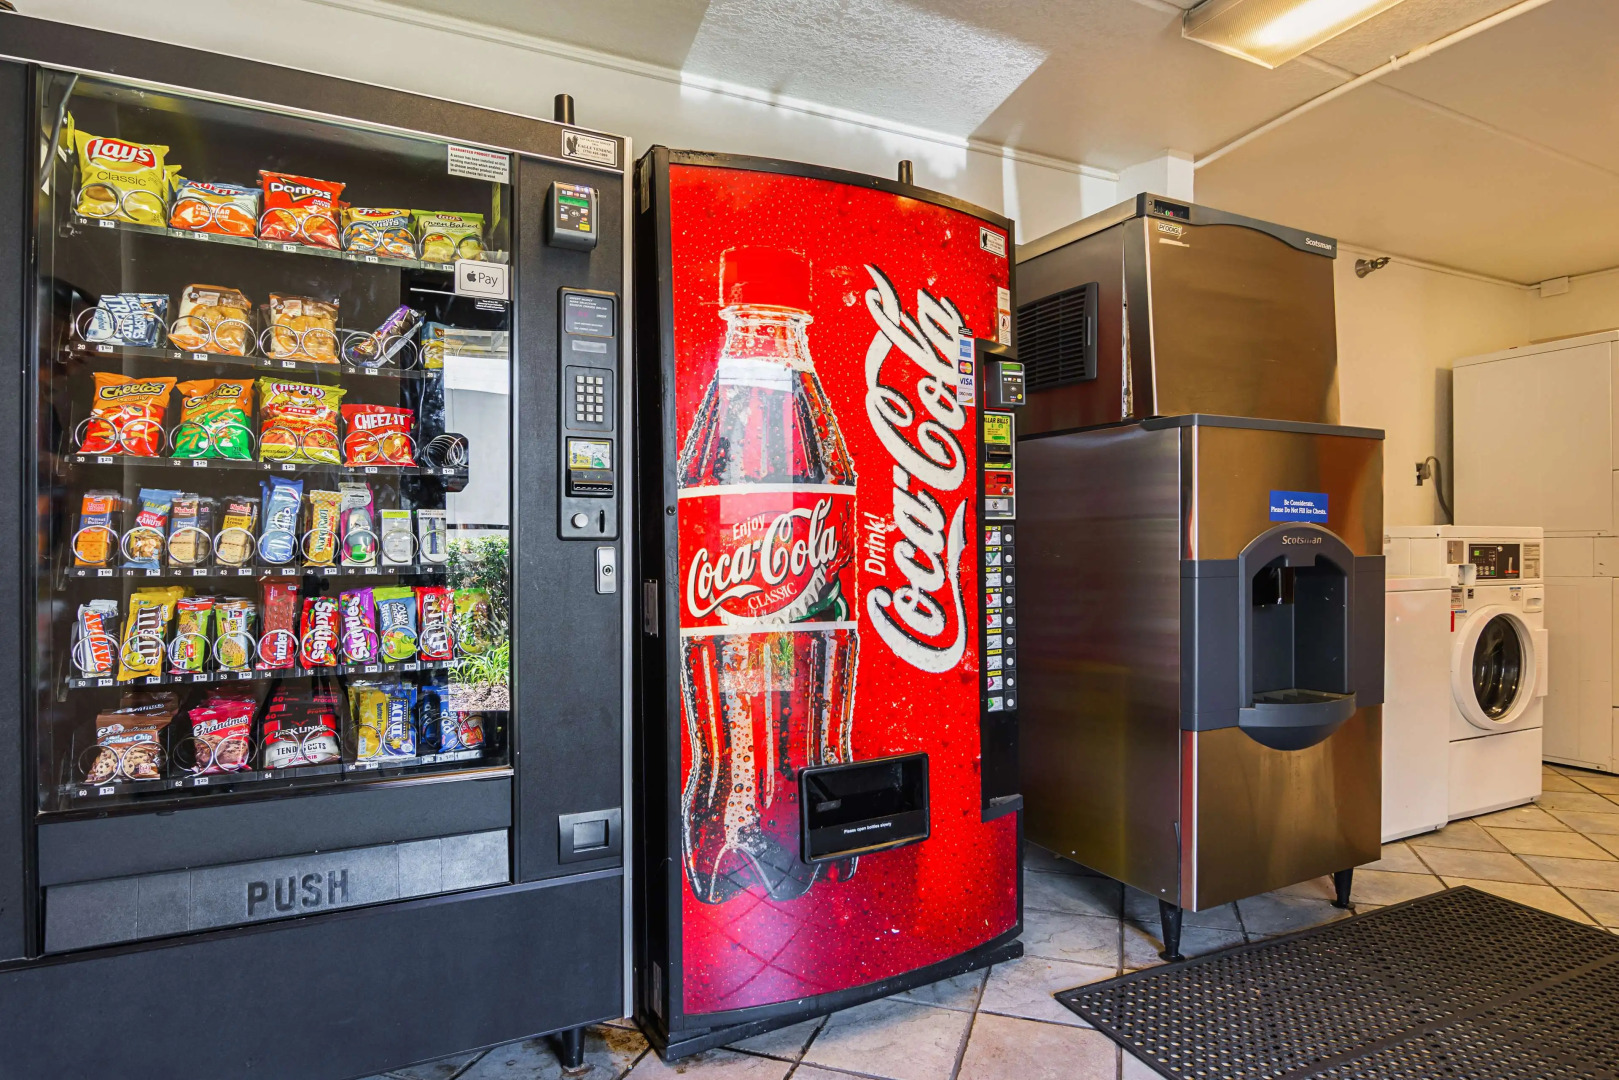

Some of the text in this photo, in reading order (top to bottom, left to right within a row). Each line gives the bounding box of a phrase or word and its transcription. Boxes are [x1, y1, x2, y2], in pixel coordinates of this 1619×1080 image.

[96, 170, 147, 187] Classic
[270, 182, 332, 200] Doritos
[1305, 237, 1332, 250] Scotsman
[478, 272, 498, 287] Pay
[101, 383, 163, 399] Cheetos
[959, 377, 973, 385] VISA
[864, 263, 968, 674] Coca-Cola
[1290, 499, 1315, 507] Considerate.
[732, 513, 766, 541] Enjoy
[864, 511, 887, 577] Drink!
[1282, 535, 1322, 545] Scotsman
[687, 495, 839, 618] Coca-Cola
[748, 582, 798, 611] CLASSIC
[382, 603, 390, 627] Bites
[311, 601, 332, 660] Skittles
[347, 596, 371, 660] Skittles
[134, 733, 153, 741] Chip
[247, 869, 348, 916] PUSH
